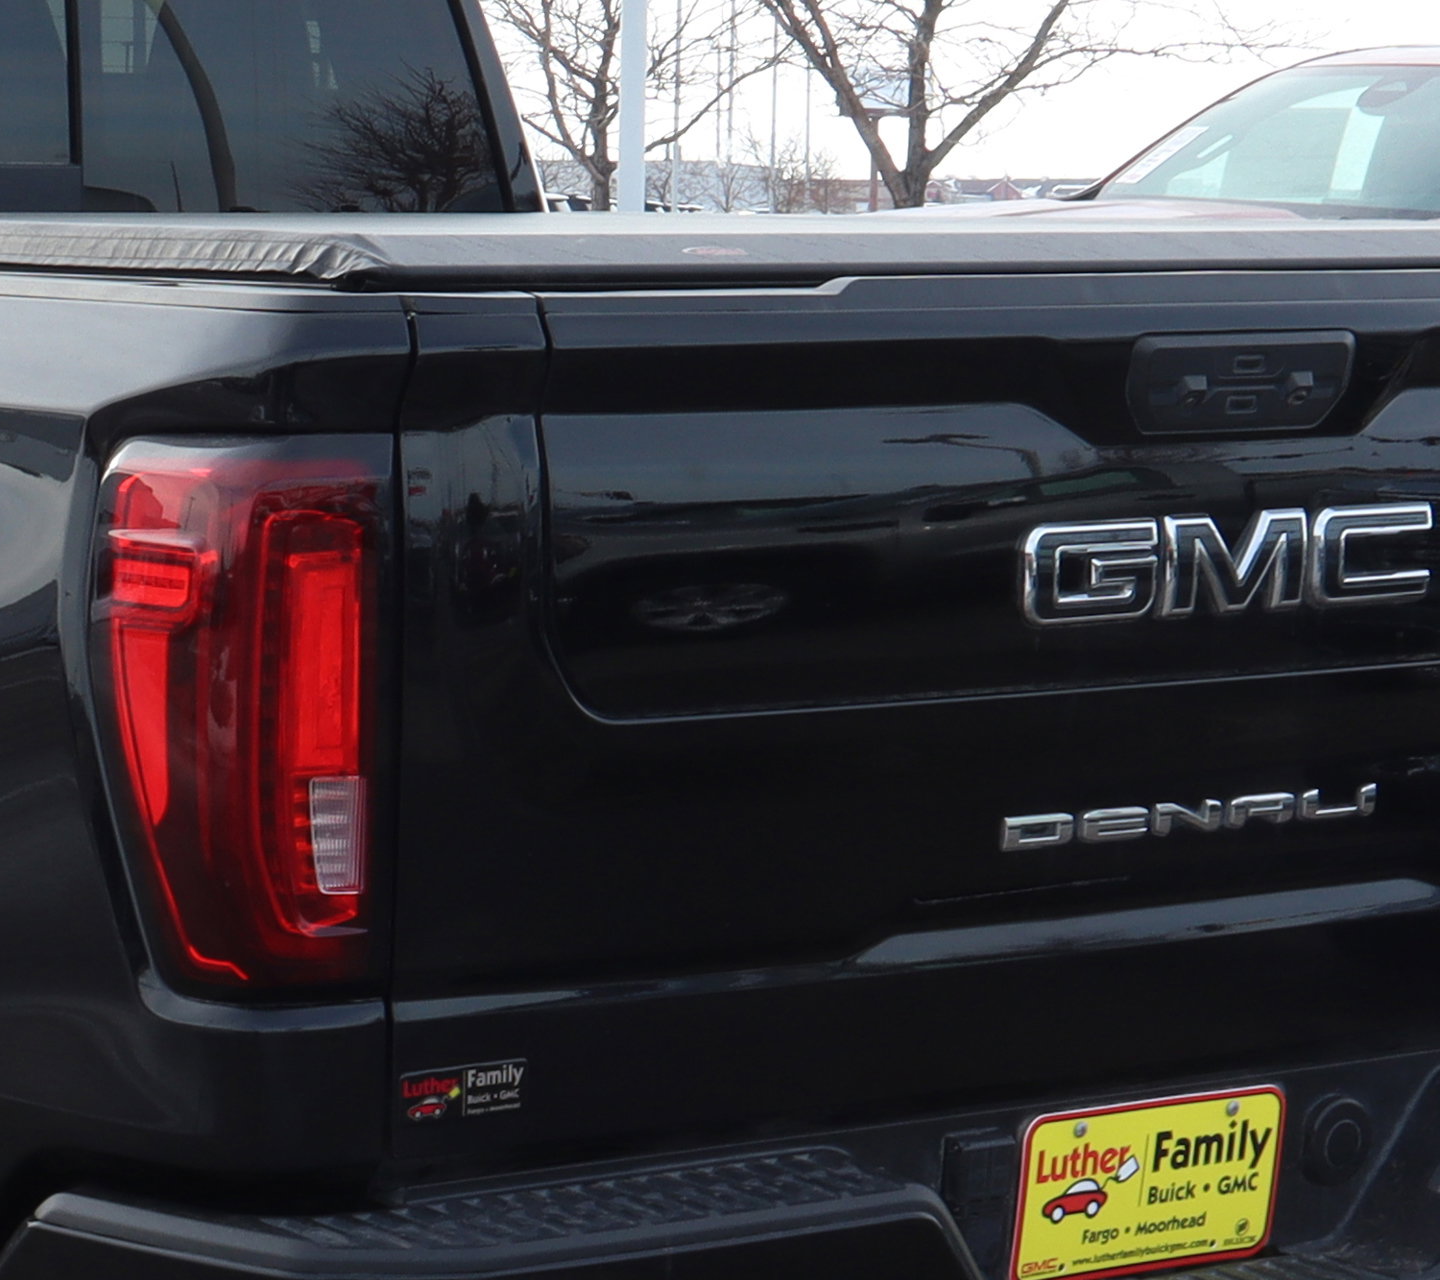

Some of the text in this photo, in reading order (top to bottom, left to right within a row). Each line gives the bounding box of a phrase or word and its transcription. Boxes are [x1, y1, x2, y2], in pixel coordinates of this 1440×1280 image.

[1021, 502, 1433, 625] GMC
[999, 782, 1378, 852] DENALI
[402, 1077, 461, 1099] Luther
[466, 1064, 525, 1088] Family
[1152, 1119, 1273, 1172] Family
[1035, 1142, 1132, 1185] Luther
[1146, 1172, 1260, 1206] Buick GMC
[1081, 1212, 1208, 1246] Fargo Moorhead
[1021, 1257, 1060, 1275] GMC
